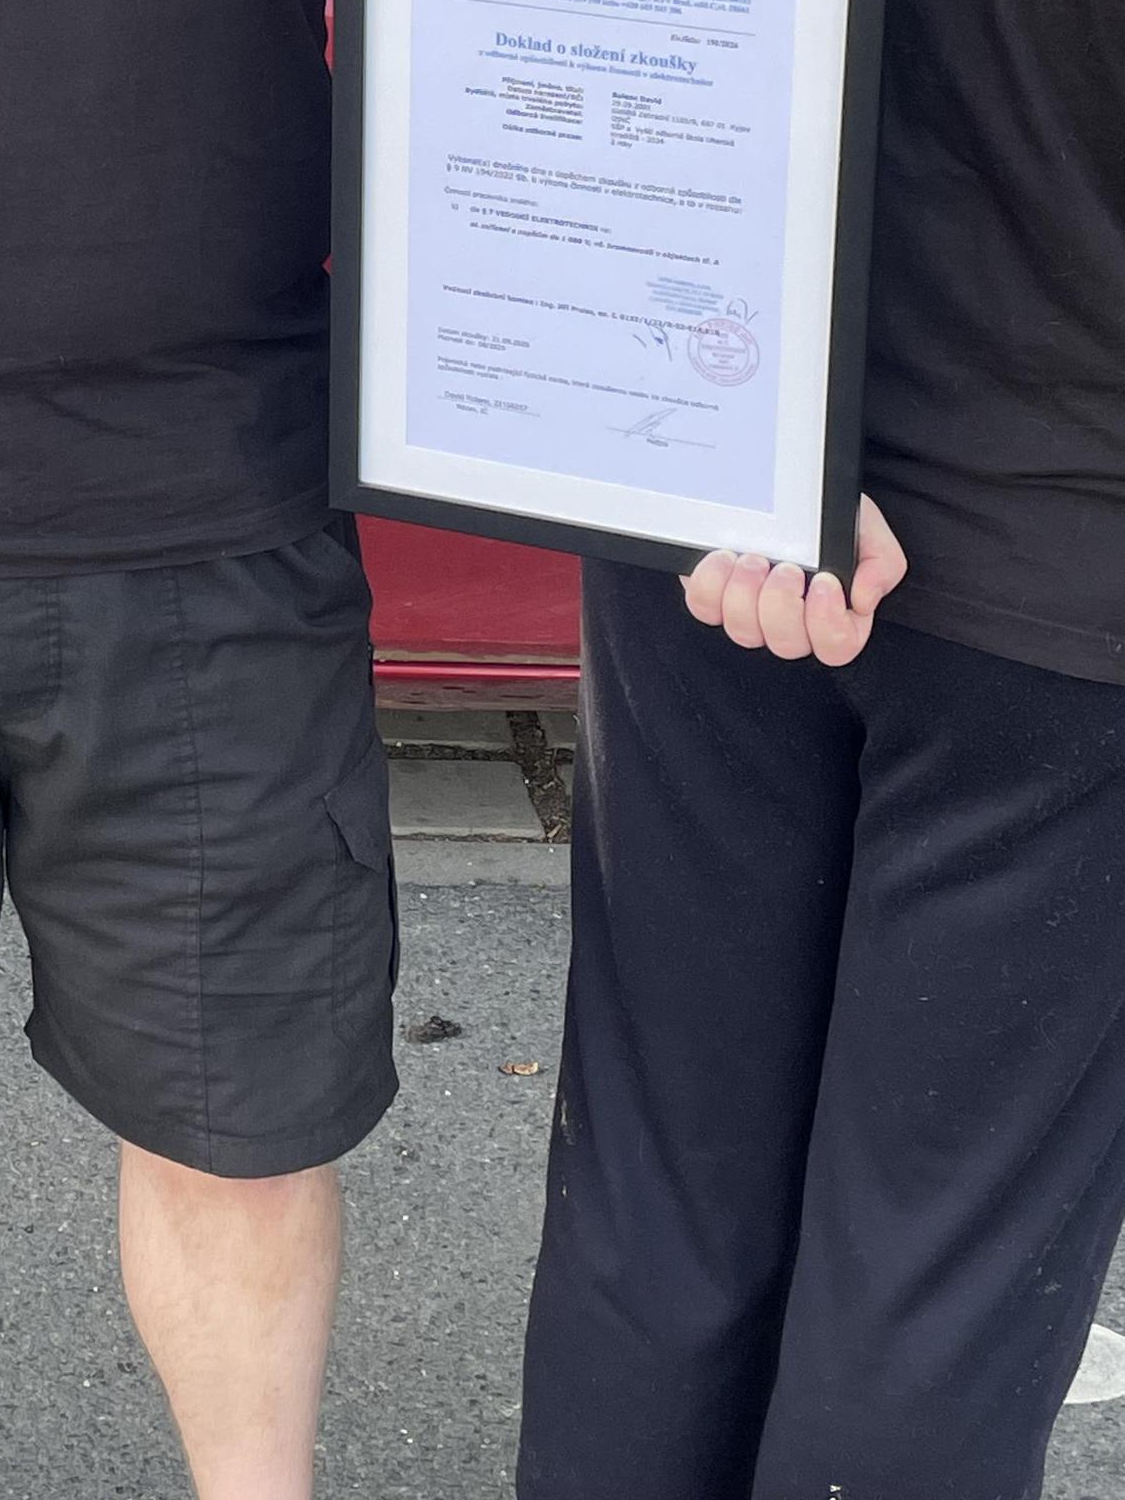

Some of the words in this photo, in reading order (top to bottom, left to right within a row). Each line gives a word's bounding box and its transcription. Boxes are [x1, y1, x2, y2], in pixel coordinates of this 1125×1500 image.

[495, 32, 552, 53] Doklad
[556, 43, 566, 55] o
[570, 42, 625, 62] složení
[629, 50, 696, 74] zkoušky
